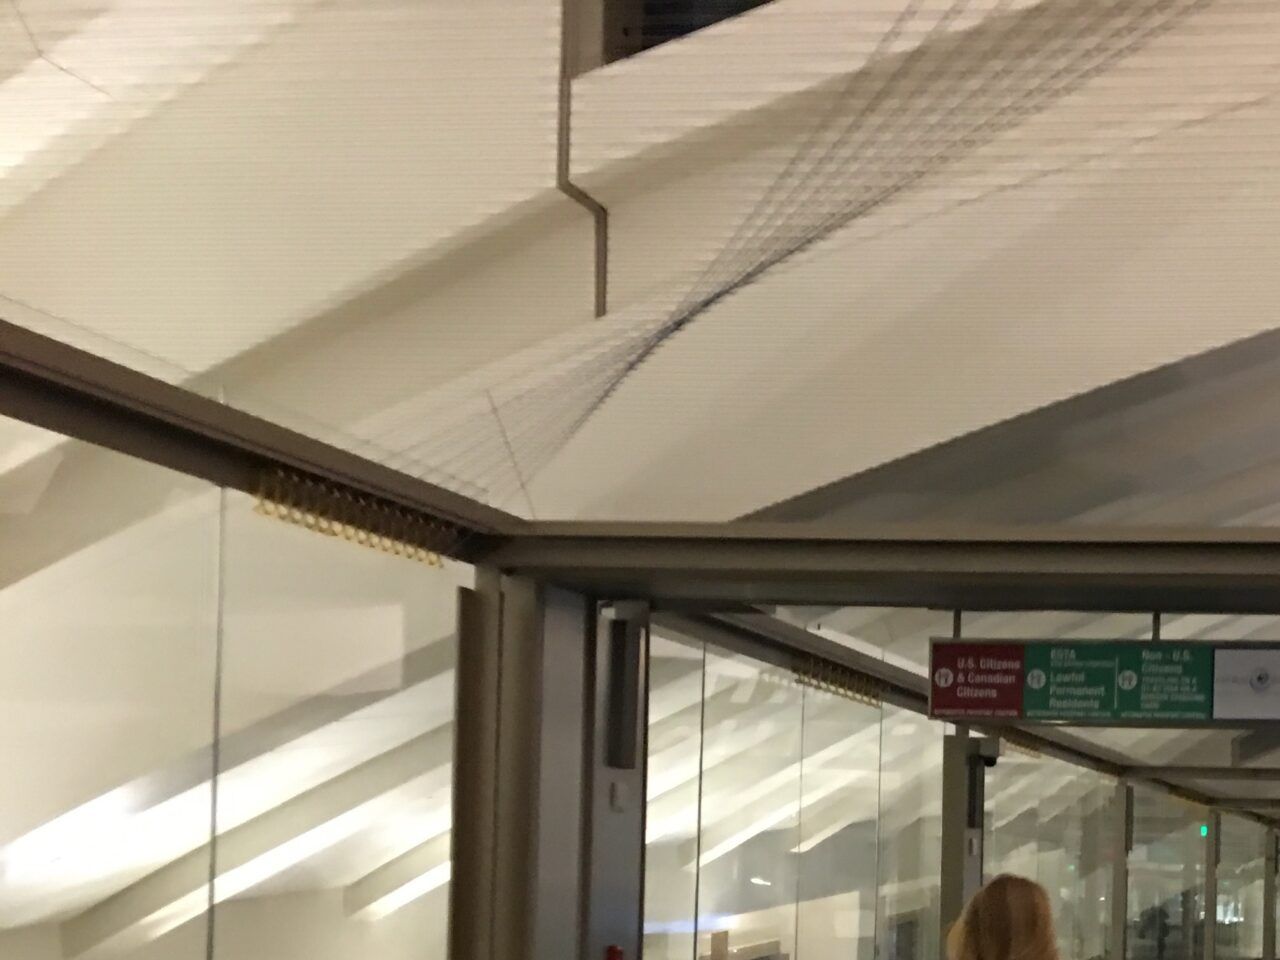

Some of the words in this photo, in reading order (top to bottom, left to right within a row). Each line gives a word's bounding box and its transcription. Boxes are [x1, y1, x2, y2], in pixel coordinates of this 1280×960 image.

[980, 657, 1021, 670] Citizens
[968, 671, 1016, 684] Canadian
[957, 686, 997, 698] Citizens
